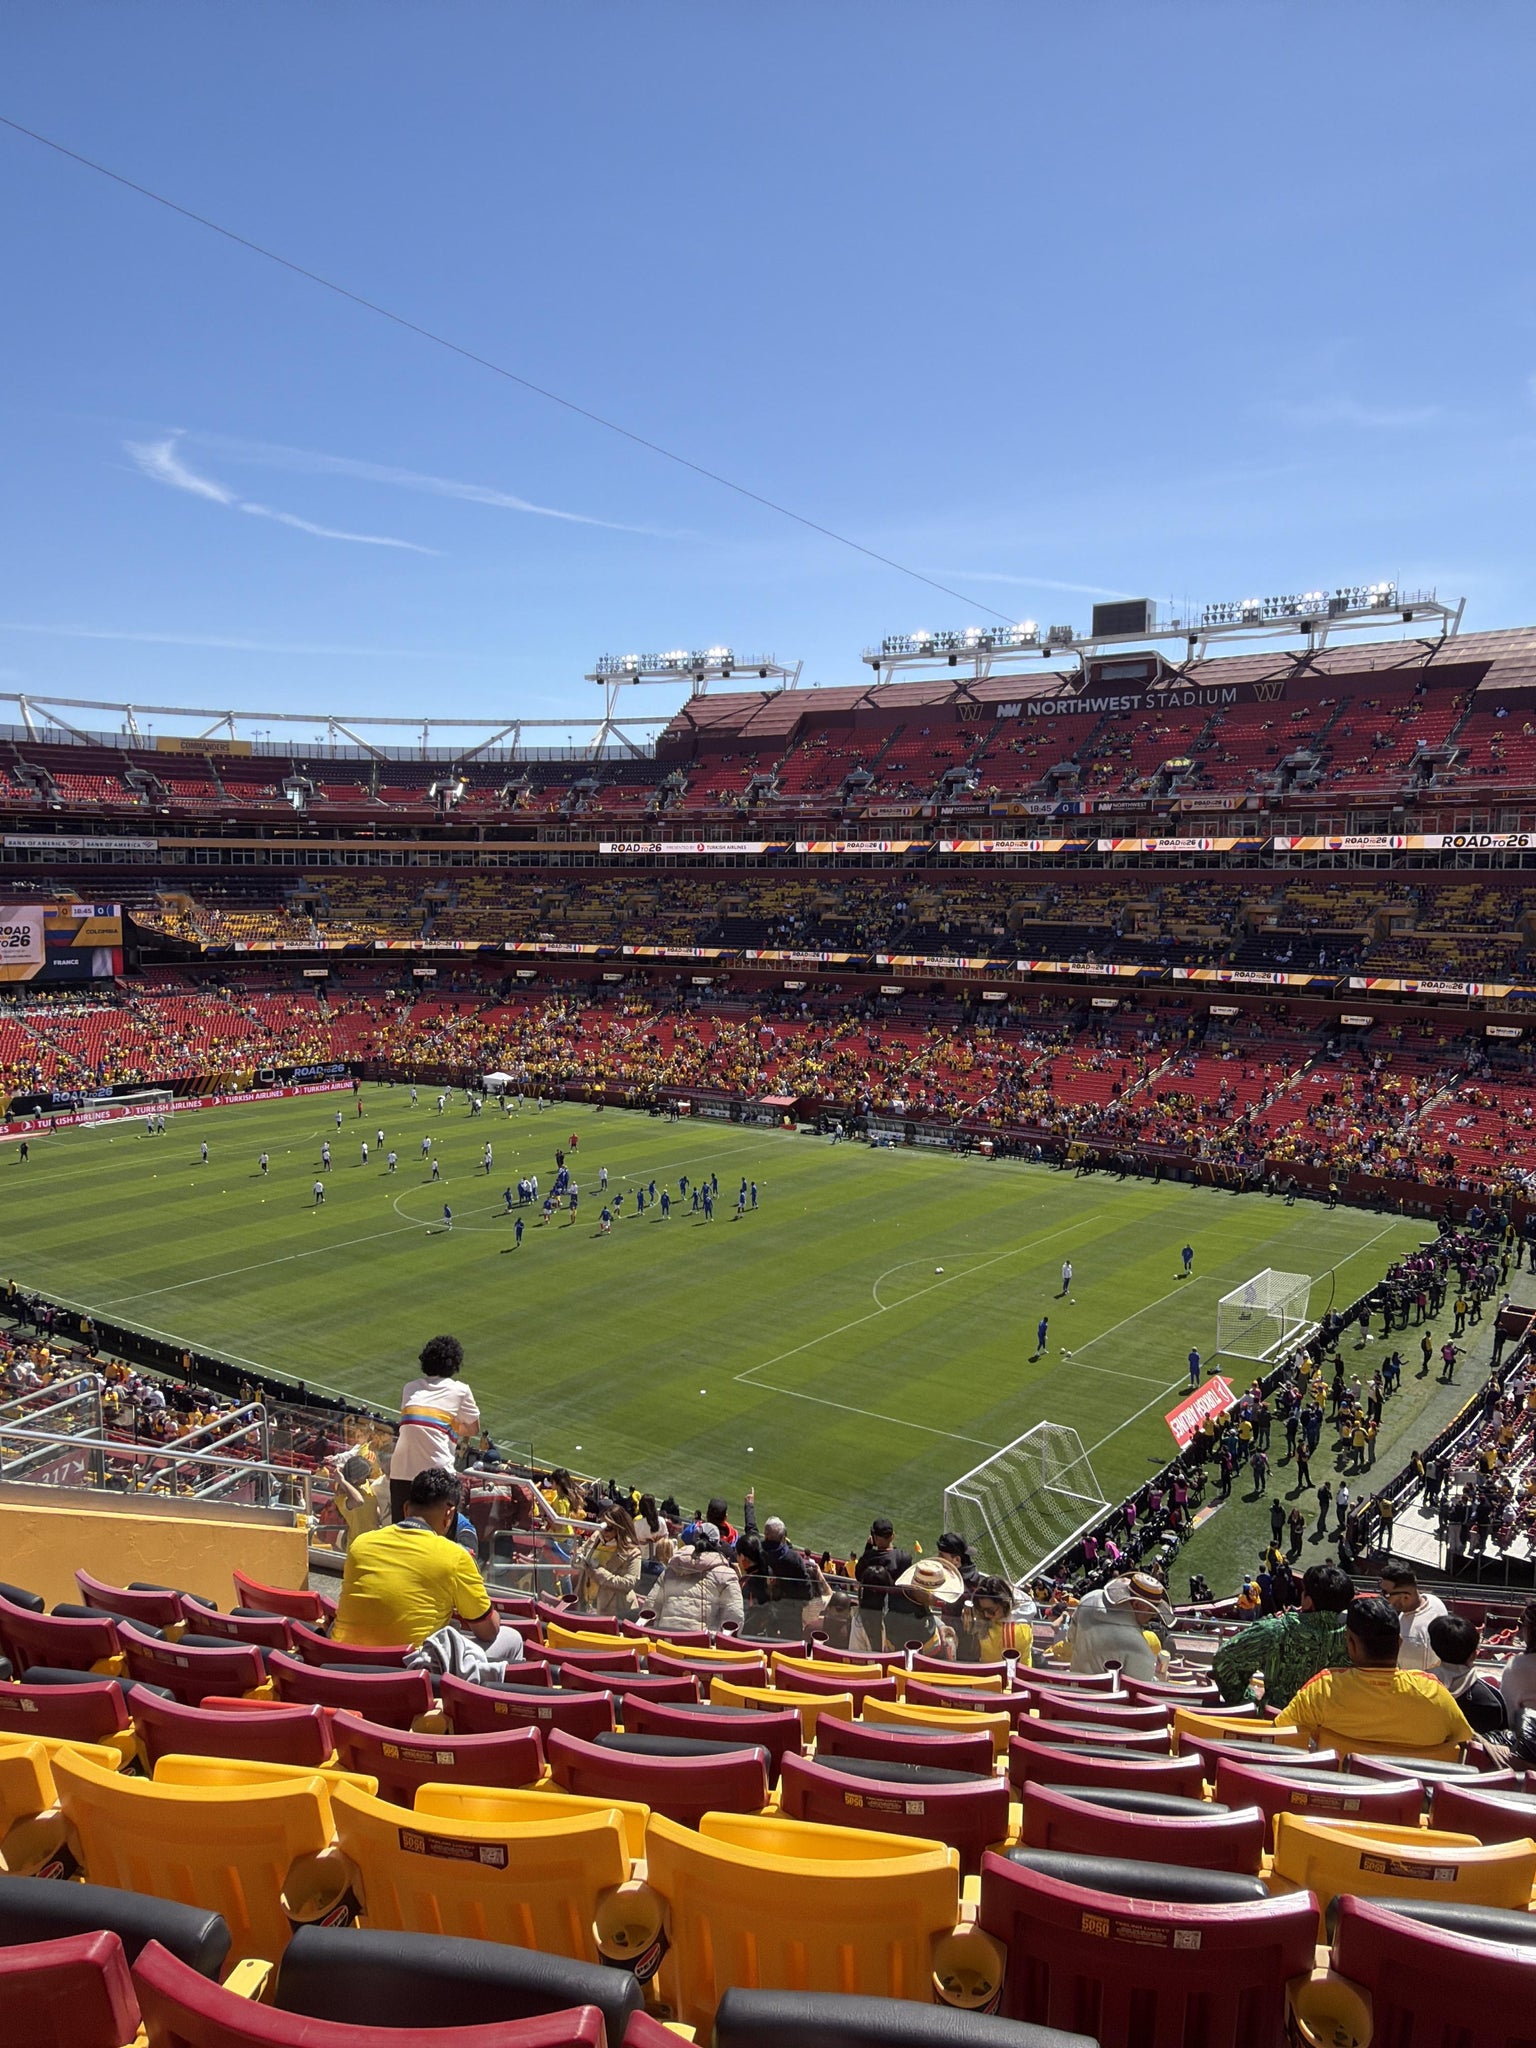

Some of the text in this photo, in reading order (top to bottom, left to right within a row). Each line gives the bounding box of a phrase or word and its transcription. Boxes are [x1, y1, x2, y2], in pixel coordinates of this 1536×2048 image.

[1027, 695, 1142, 716] NORTHWEST
[1146, 687, 1237, 708] STADIUM
[180, 741, 230, 751] COMMANDERS
[1013, 803, 1069, 813] 0 18:45 0
[1113, 801, 1147, 809] NORTHWEST
[97, 907, 104, 915] 0
[303, 1081, 354, 1093] TURKISH AIRLINE
[225, 1090, 284, 1103] TURKISH AIRLINES
[135, 1100, 203, 1114] TURKISH AIRLINES
[74, 1110, 111, 1123] AIRLINES
[1170, 1389, 1223, 1438] TURKISH AIRLINES
